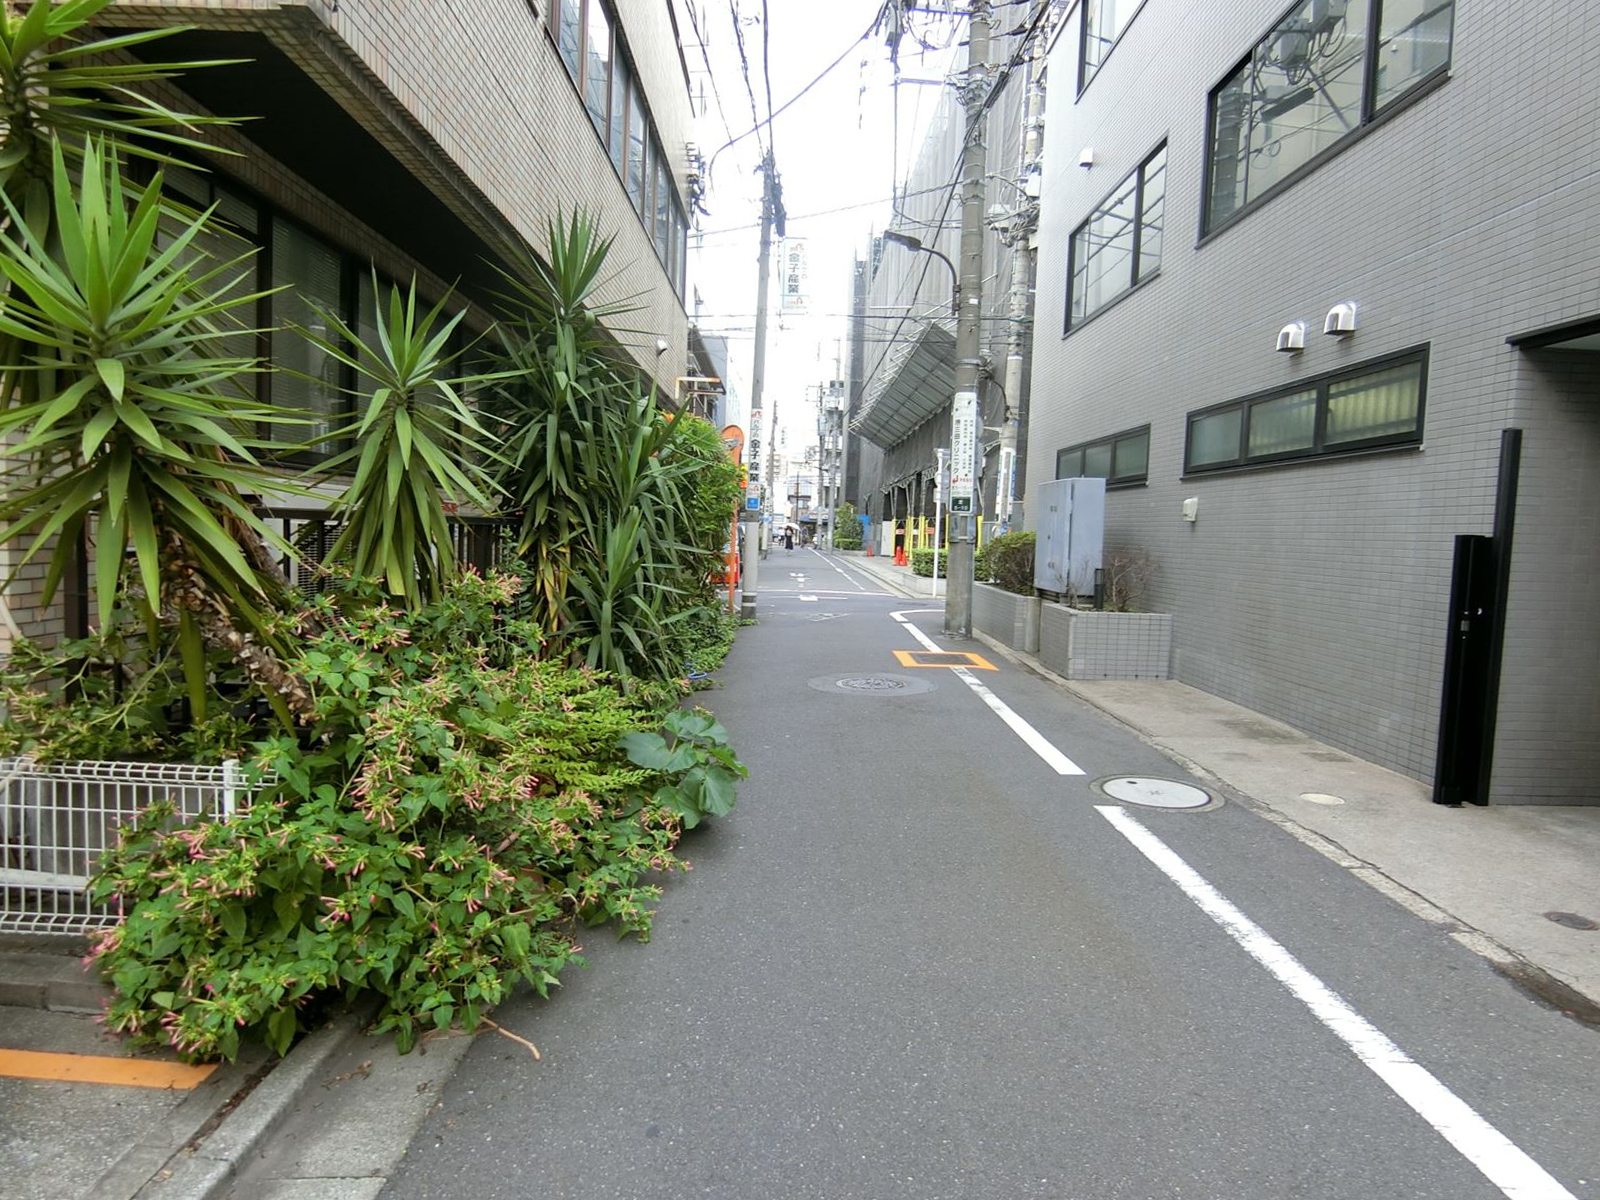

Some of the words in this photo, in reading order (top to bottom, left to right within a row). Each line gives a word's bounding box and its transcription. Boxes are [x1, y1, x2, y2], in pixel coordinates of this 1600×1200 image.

[788, 253, 800, 293] 金子産業
[749, 439, 761, 482] 金子産業
